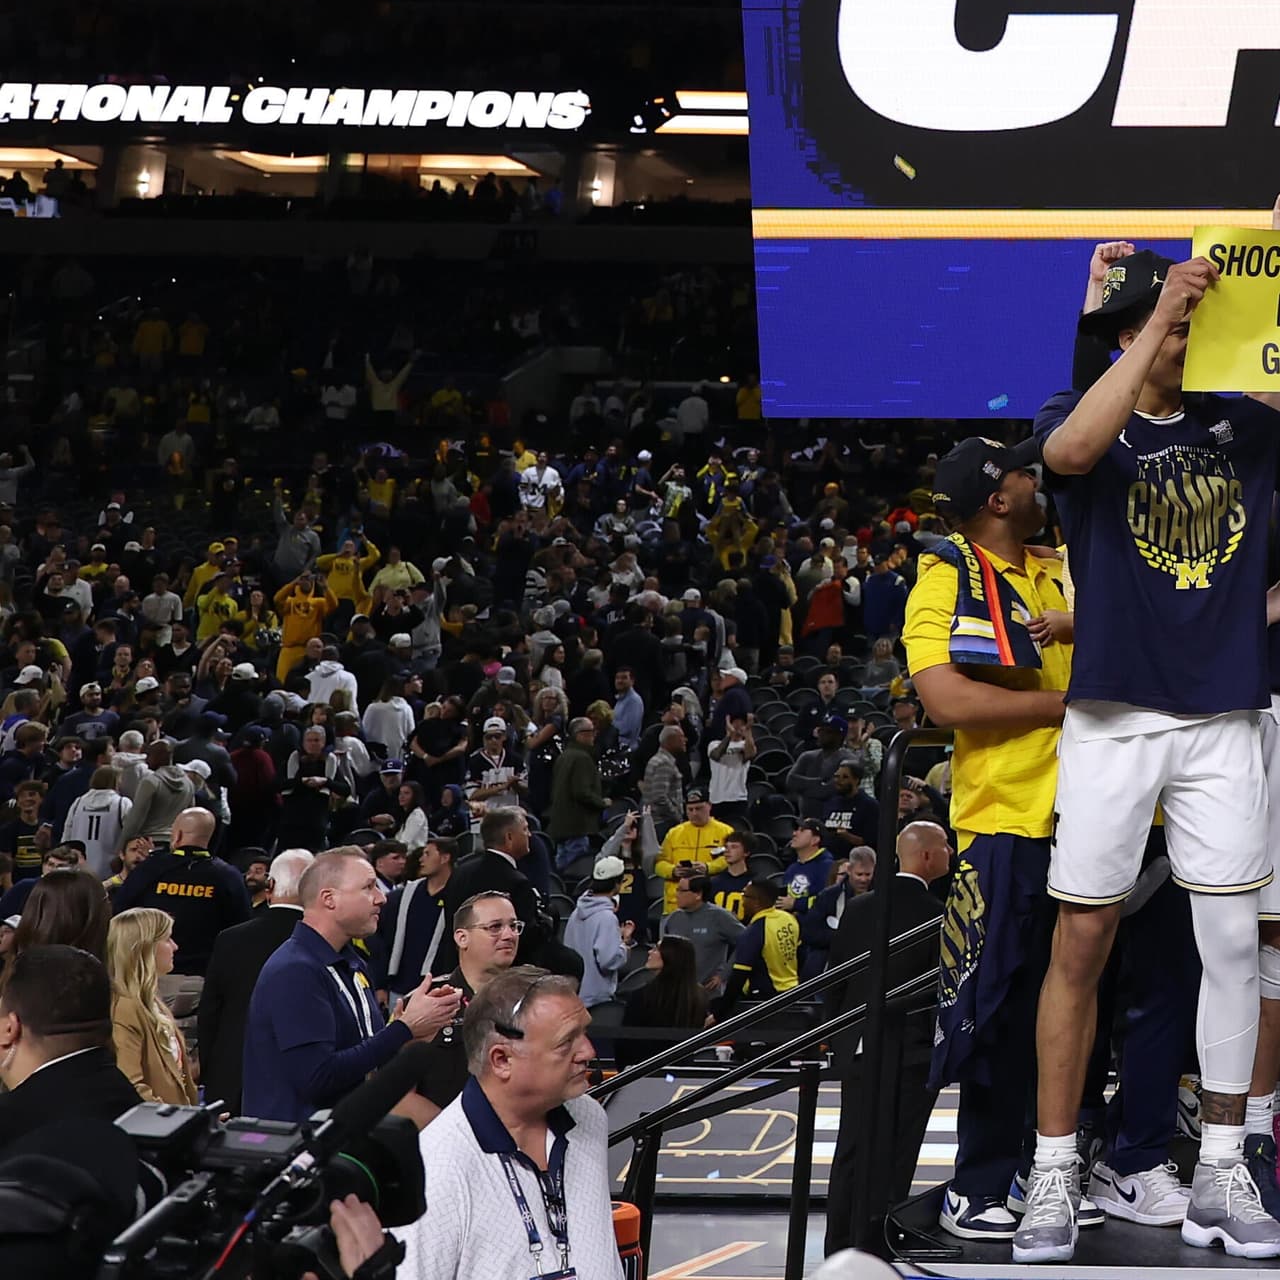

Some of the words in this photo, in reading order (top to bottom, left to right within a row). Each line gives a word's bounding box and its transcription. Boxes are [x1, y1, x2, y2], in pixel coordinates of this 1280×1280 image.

[242, 87, 588, 129] CHAMPIONS
[1126, 471, 1247, 558] CHAMPS
[1175, 562, 1212, 590] M
[88, 815, 101, 841] 11
[156, 881, 214, 898] POLICE
[714, 890, 745, 920] 10
[776, 923, 794, 941] CSC
